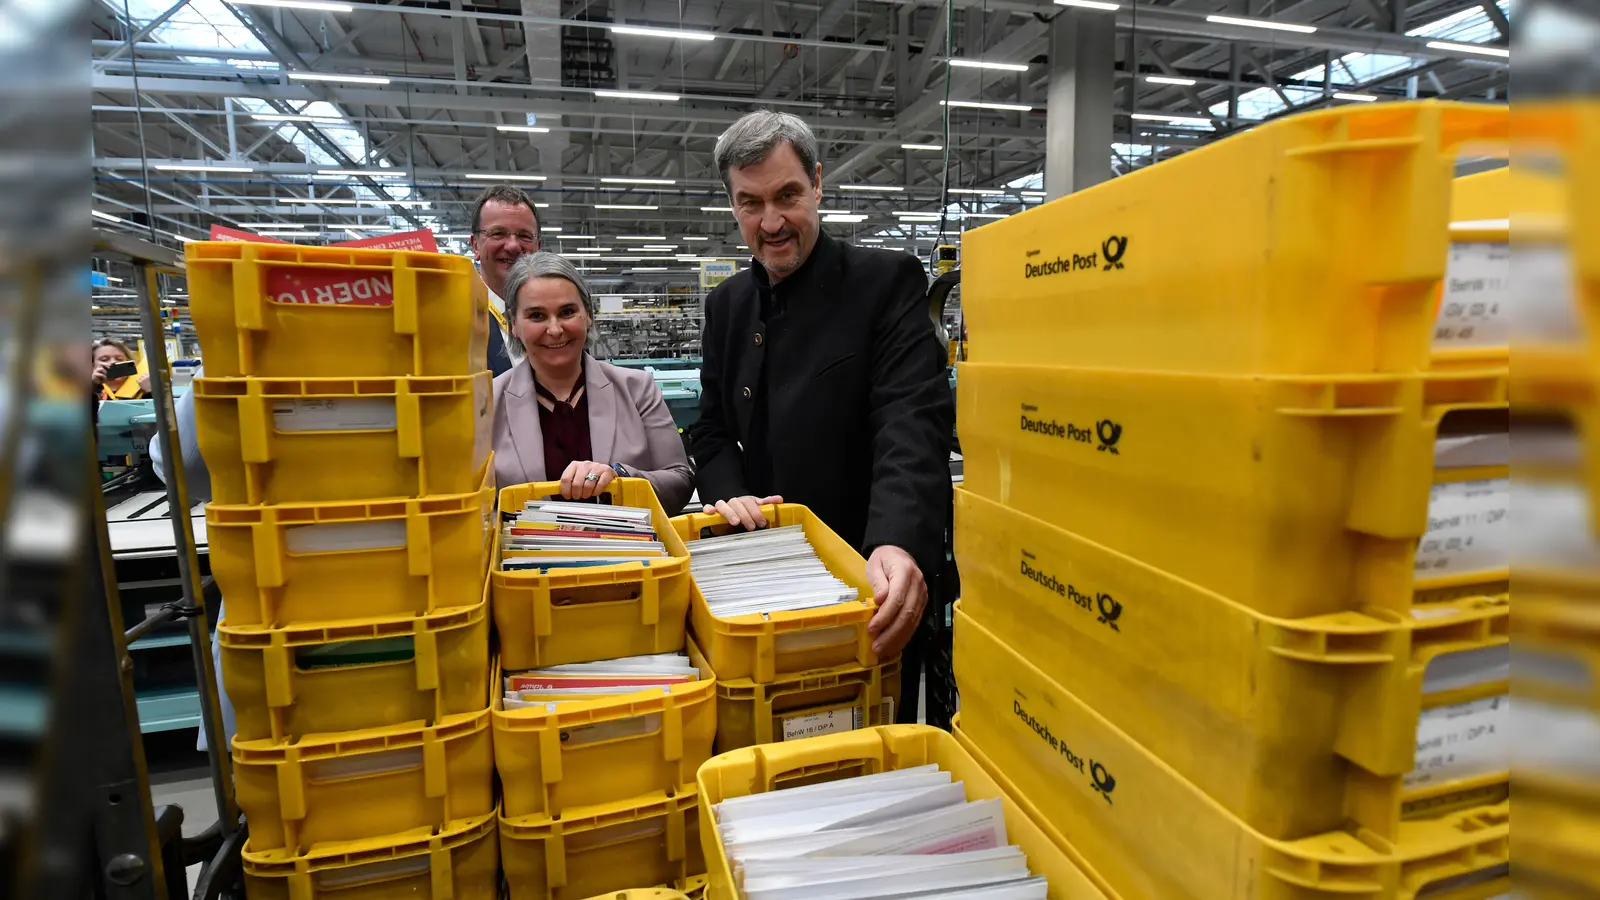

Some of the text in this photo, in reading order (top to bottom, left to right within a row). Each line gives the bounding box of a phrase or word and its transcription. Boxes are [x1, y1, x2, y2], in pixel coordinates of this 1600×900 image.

[1025, 252, 1097, 279] Deutsche Post
[1021, 415, 1092, 444] Deutsche Post
[1021, 560, 1092, 612] Deutsche Post
[828, 710, 833, 719] 2
[786, 728, 805, 738] BehW
[1014, 700, 1085, 775] Deutsche Post
